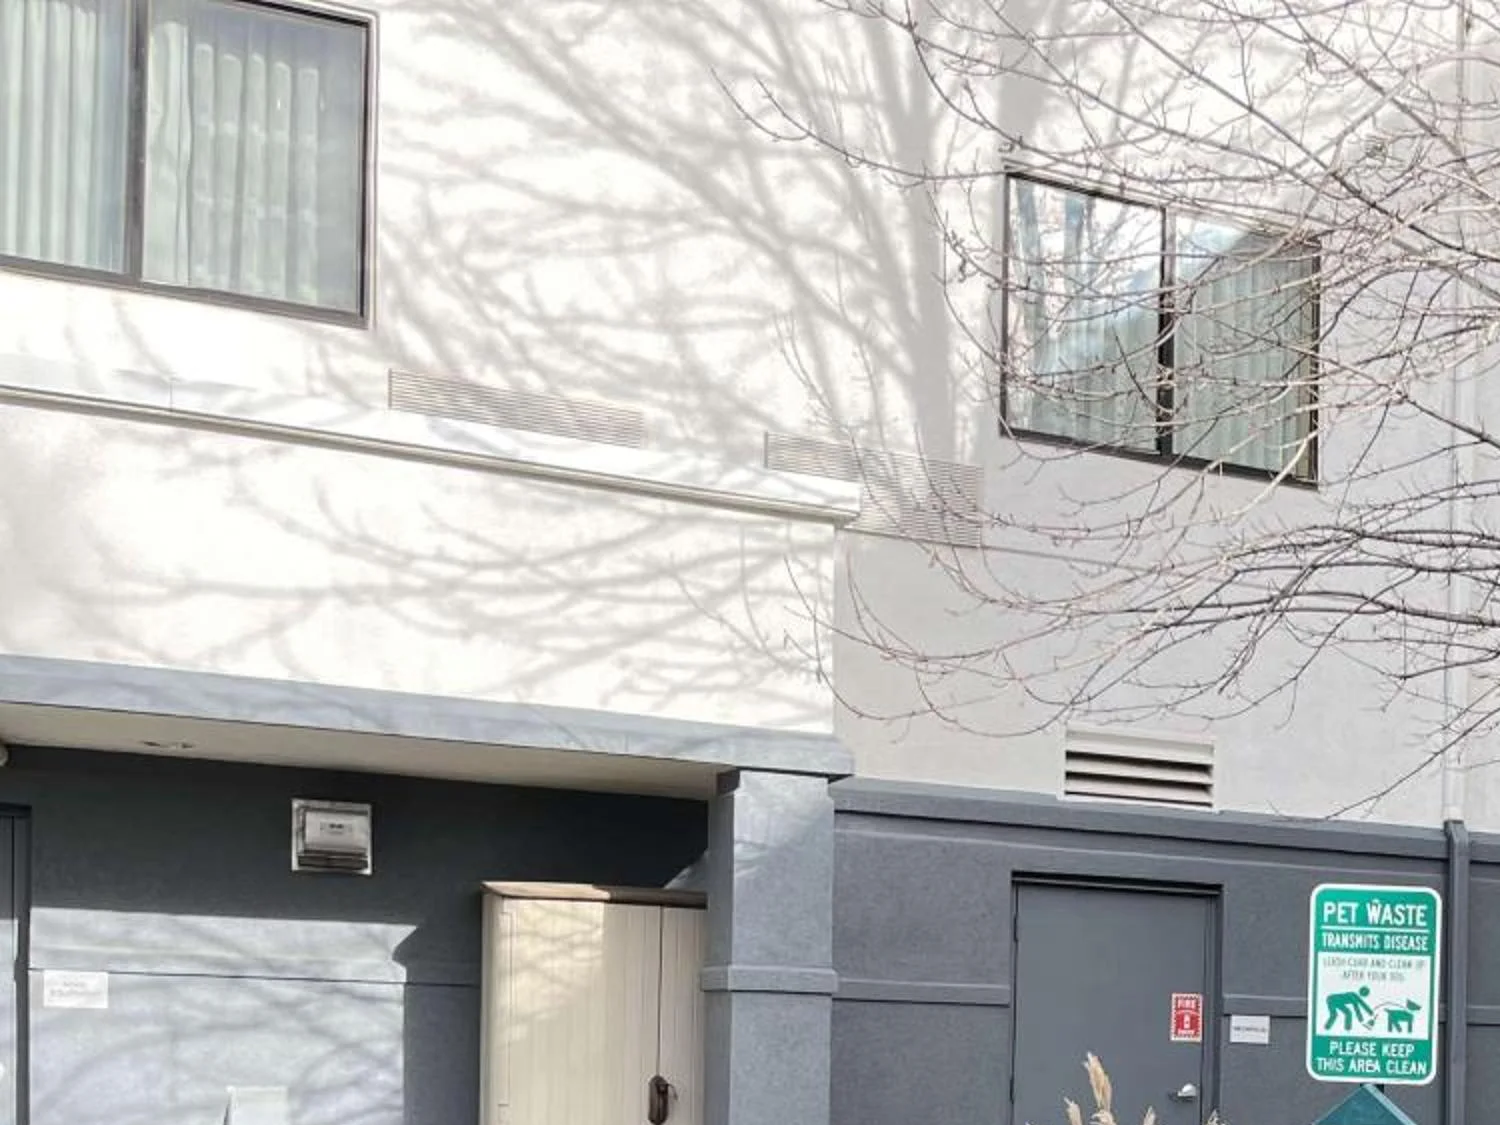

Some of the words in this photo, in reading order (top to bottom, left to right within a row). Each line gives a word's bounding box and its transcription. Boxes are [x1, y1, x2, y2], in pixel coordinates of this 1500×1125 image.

[1323, 901, 1358, 924] PET
[1366, 902, 1427, 927] WASTE
[1321, 932, 1380, 949] TRANSMITS
[1383, 935, 1429, 952] DISEASE
[1329, 1041, 1377, 1057] PLEASE
[1381, 1044, 1415, 1058] KEEP
[1316, 1056, 1344, 1072] THIS
[1347, 1058, 1380, 1073] AREA
[1386, 1060, 1427, 1075] CLEAN
